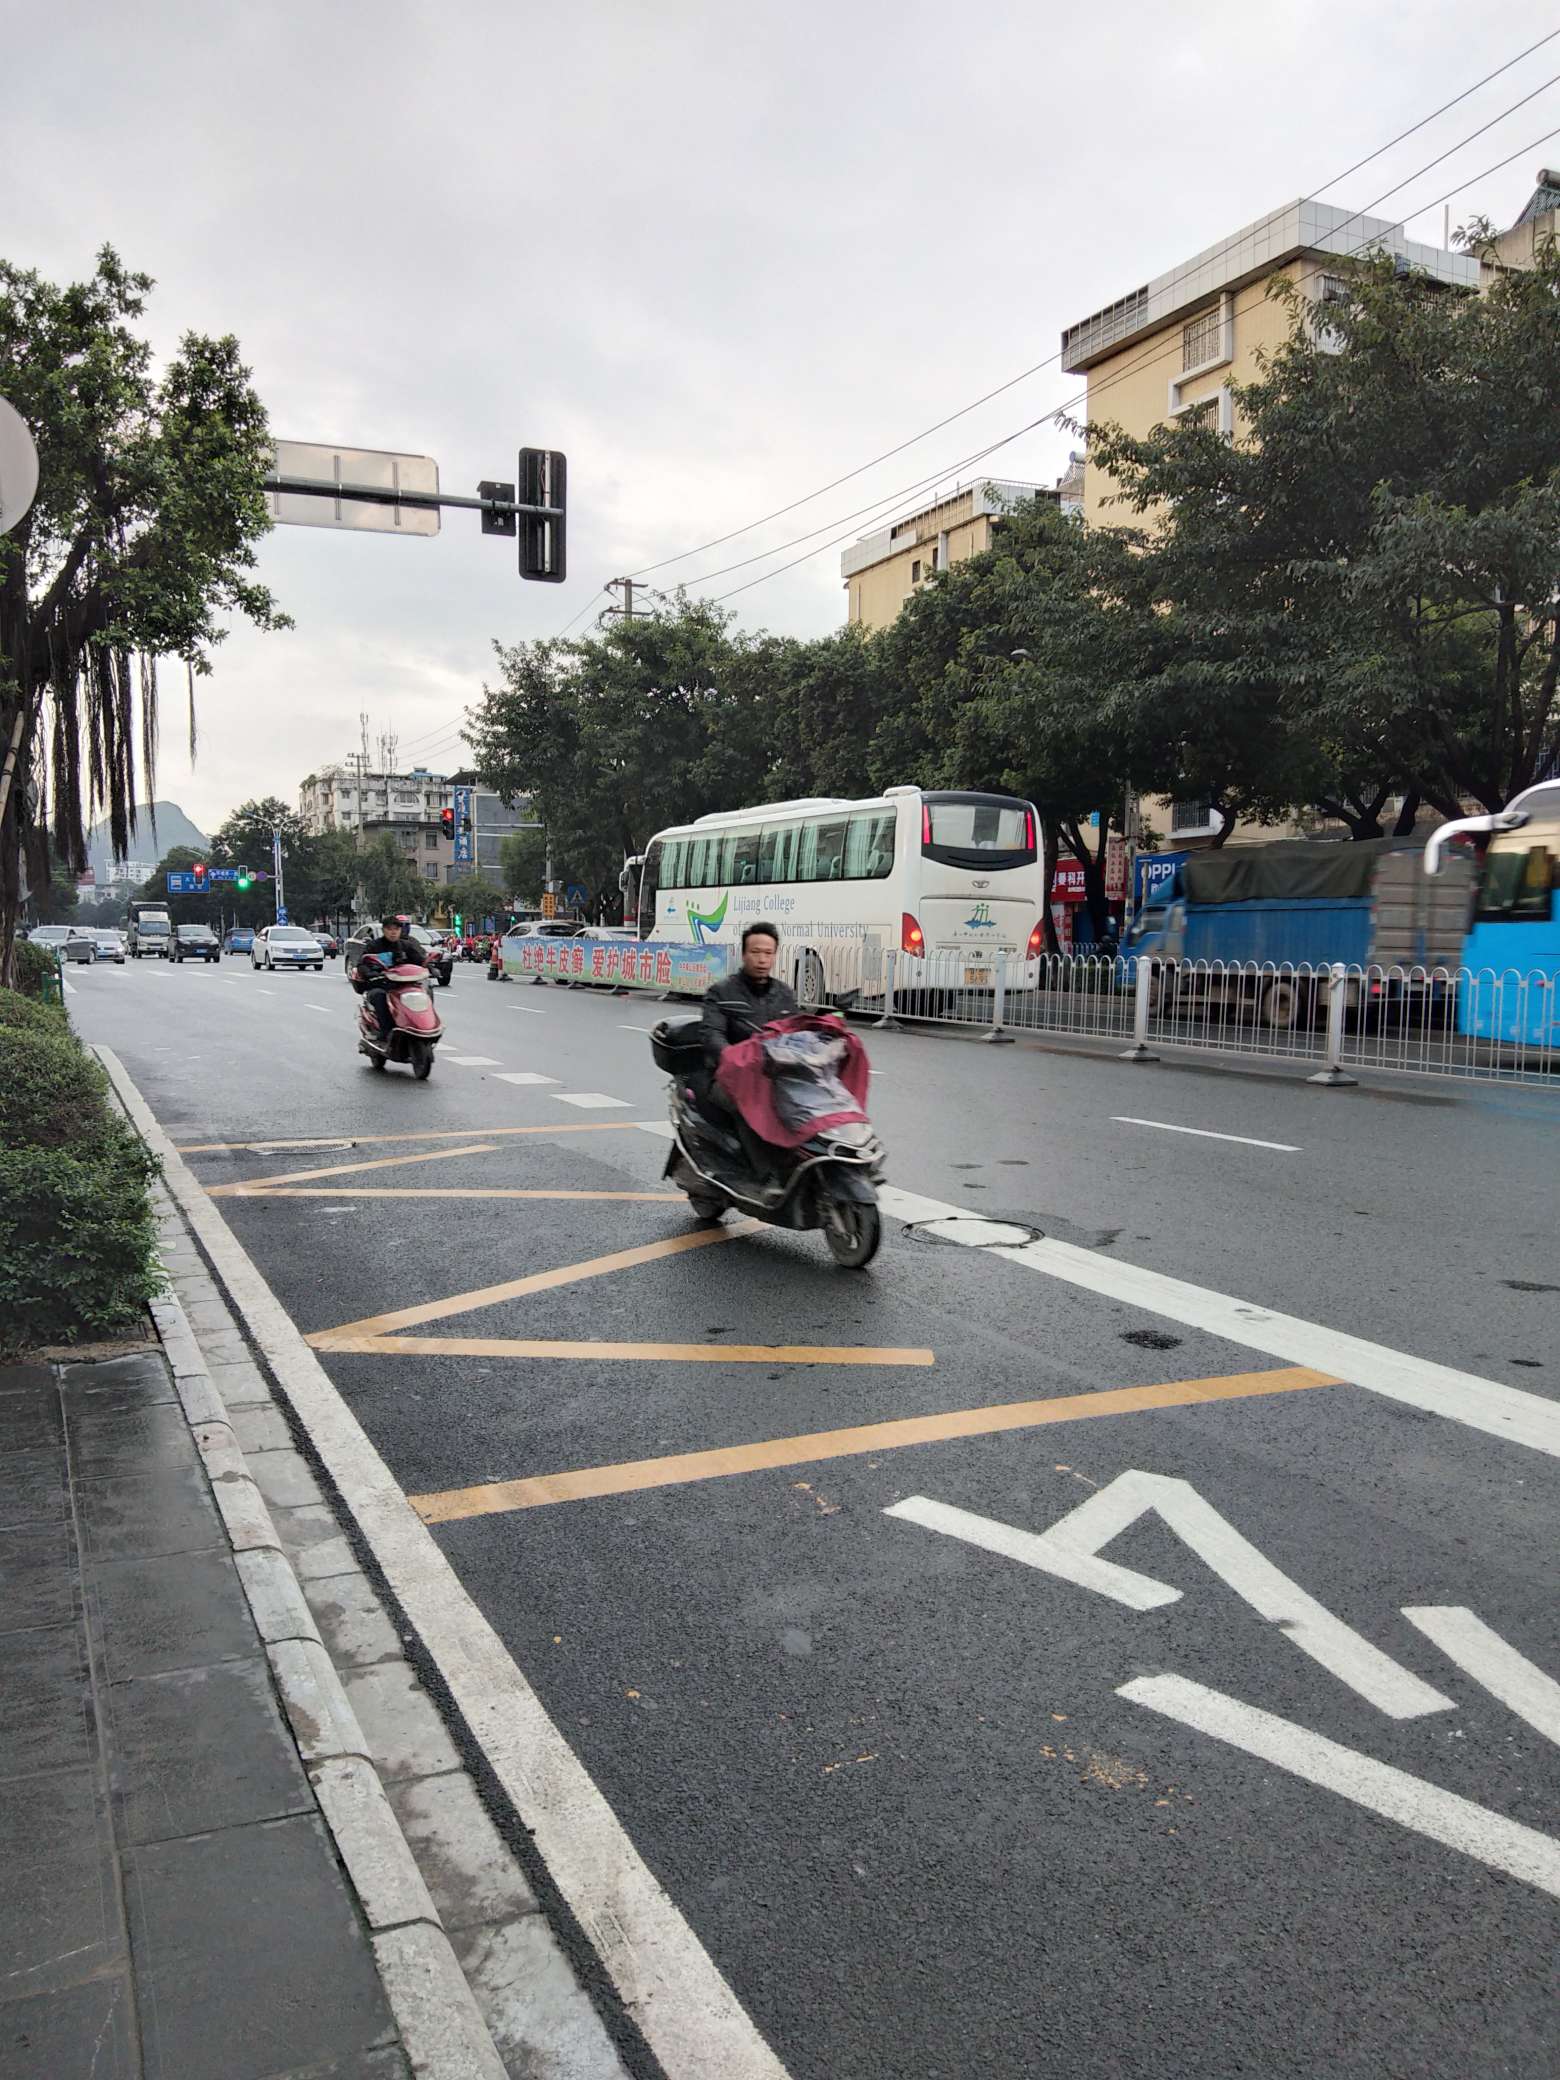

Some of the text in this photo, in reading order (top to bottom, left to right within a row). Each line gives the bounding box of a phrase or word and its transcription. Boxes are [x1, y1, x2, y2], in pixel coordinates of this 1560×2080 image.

[733, 894, 796, 915] Lijiang College
[781, 921, 813, 938] Normal
[816, 921, 870, 939] University
[591, 947, 672, 985] 爱护城市脸
